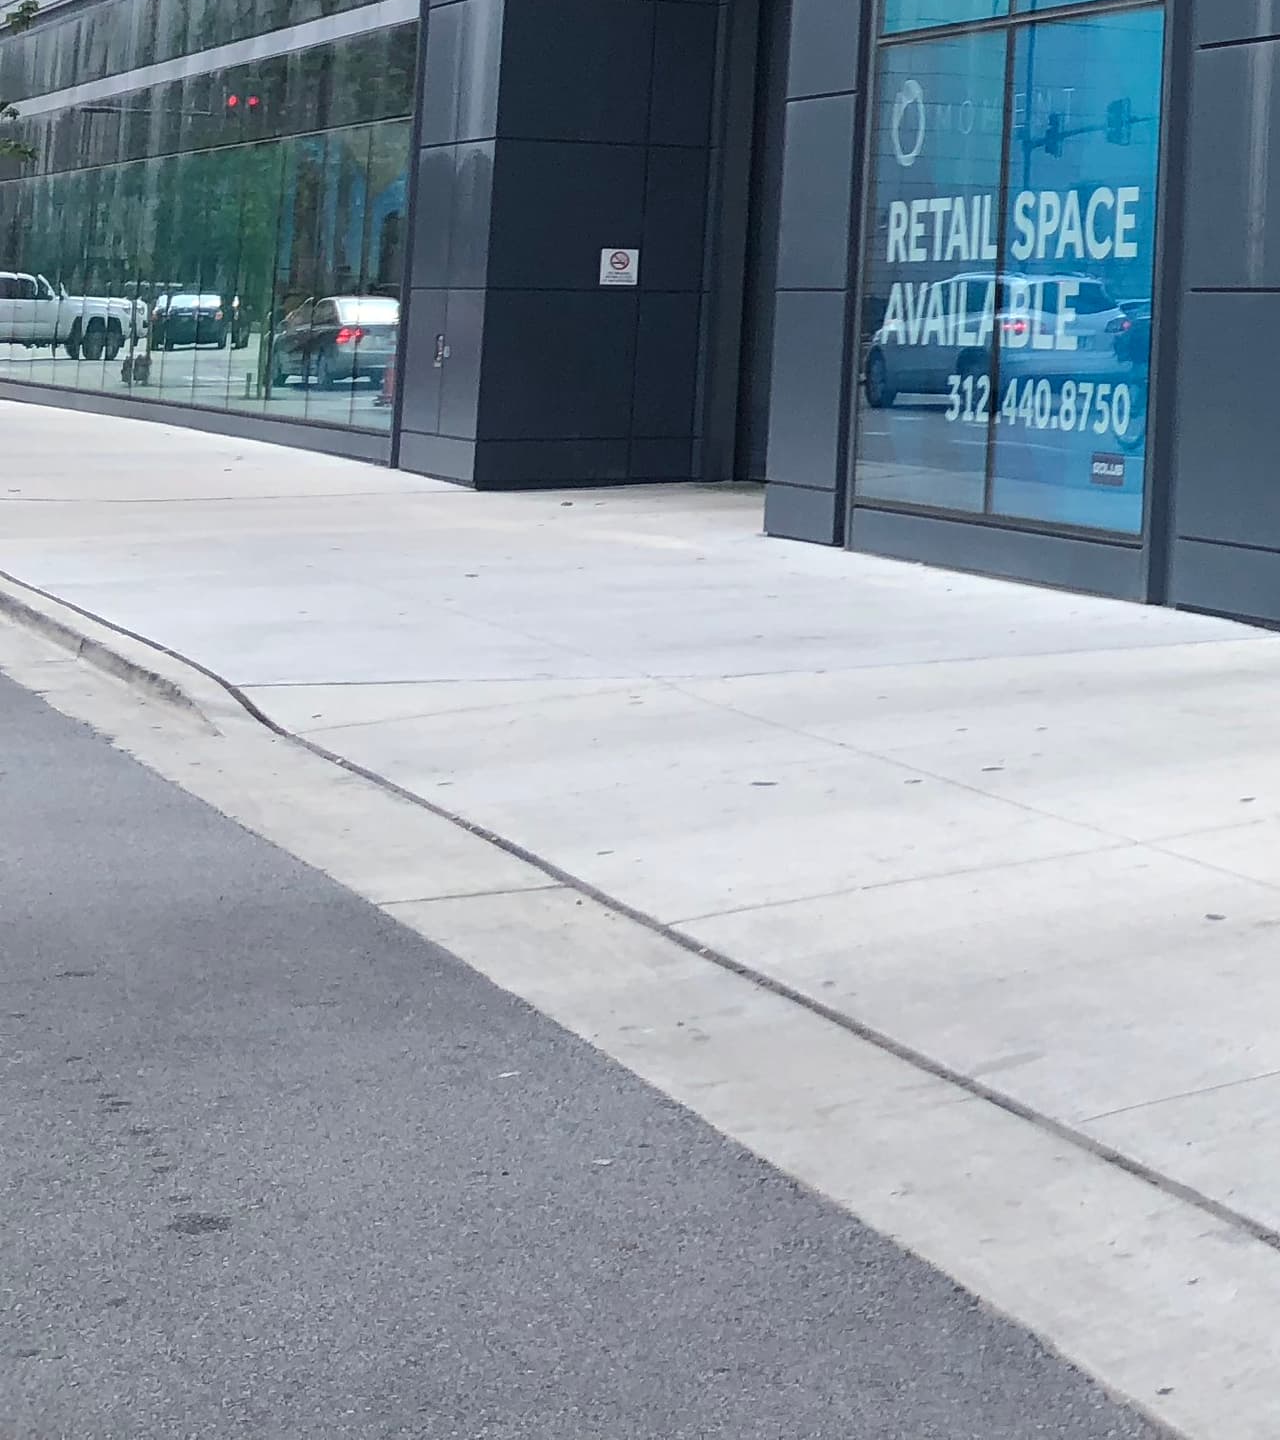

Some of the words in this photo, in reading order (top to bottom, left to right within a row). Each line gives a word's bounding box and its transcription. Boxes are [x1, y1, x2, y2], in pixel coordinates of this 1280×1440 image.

[886, 194, 998, 263] RETAIL
[1011, 186, 1140, 261] SPACE
[879, 280, 1081, 351] AVAILABLE
[944, 375, 1131, 436] 312.440.8750
